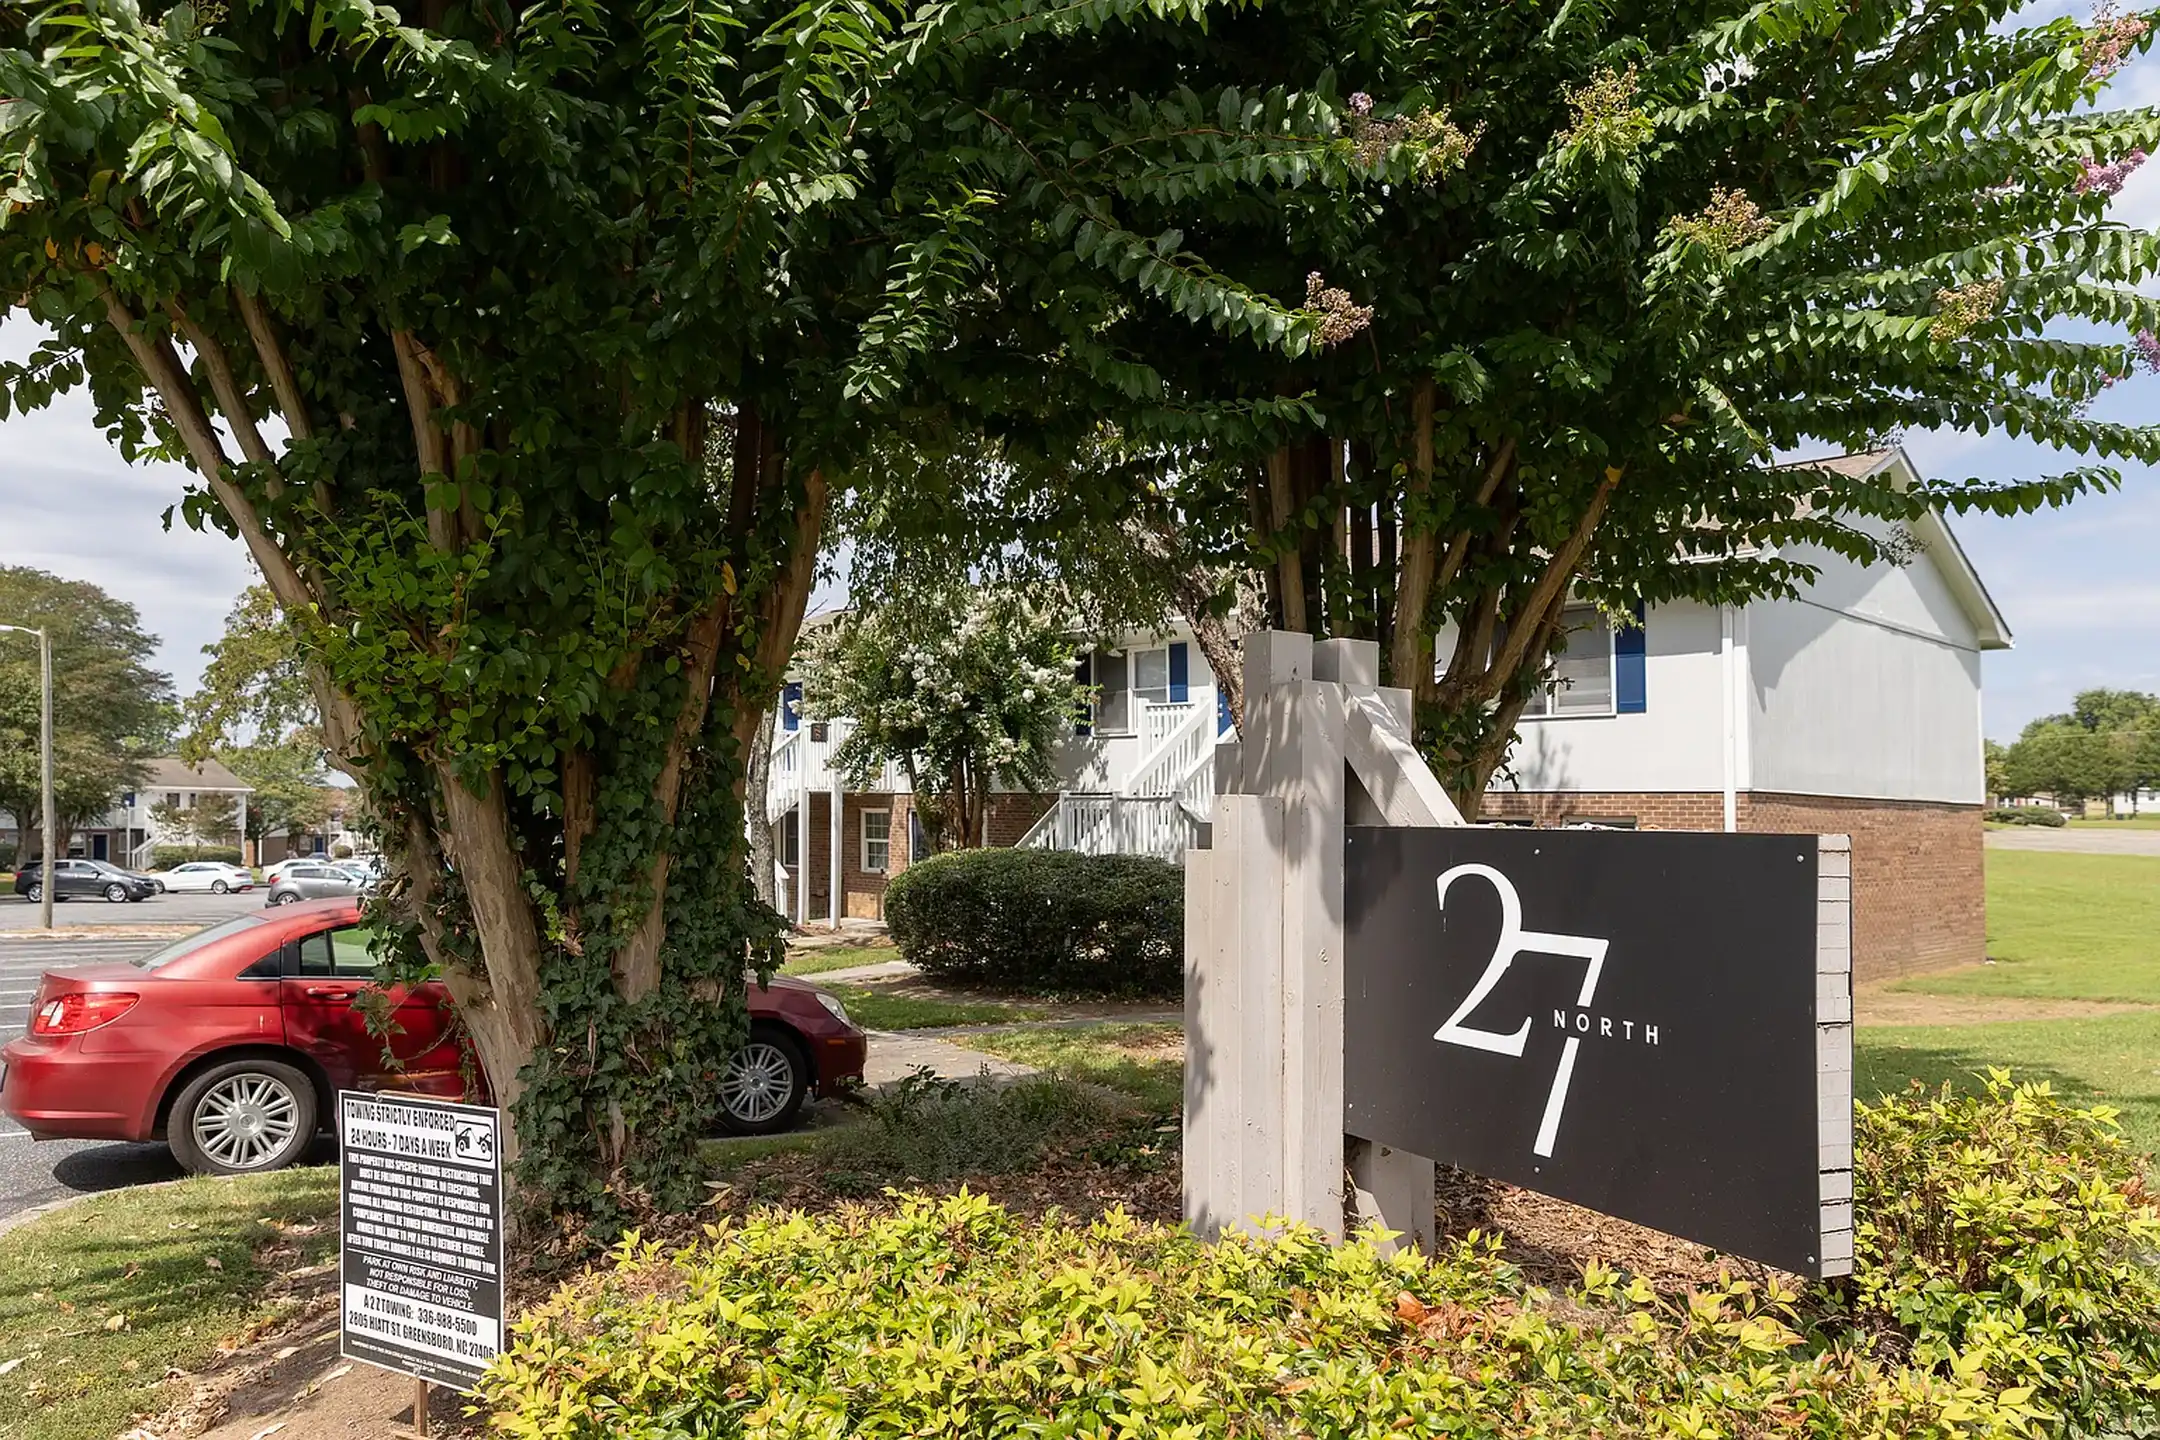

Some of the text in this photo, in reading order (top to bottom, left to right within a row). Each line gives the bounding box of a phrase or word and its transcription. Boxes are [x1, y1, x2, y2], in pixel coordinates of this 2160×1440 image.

[1433, 863, 1610, 1158] 27
[1553, 1008, 1659, 1046] NORTH
[347, 1102, 455, 1133] TOWING STRICTLY ENFORCED
[351, 1129, 361, 1146] 24
[363, 1130, 387, 1150] HOURS
[393, 1134, 398, 1151] 7
[400, 1135, 420, 1154] DAYS
[422, 1138, 427, 1156] A
[429, 1139, 452, 1159] WEEK
[363, 1255, 479, 1291] PARK AT OWN RISK AND LIABILITY,
[370, 1267, 471, 1301] NOT RESPONSIBLE FOR LOSS,
[367, 1278, 475, 1312] THEFT OR DAMAGE TO VEHICLE.
[349, 1311, 368, 1329] 2805
[370, 1316, 390, 1334] HIATT
[391, 1321, 401, 1337] ST.
[457, 1339, 468, 1354] NC
[470, 1342, 495, 1361] 27406
[418, 1309, 478, 1337] 336-988-5500
